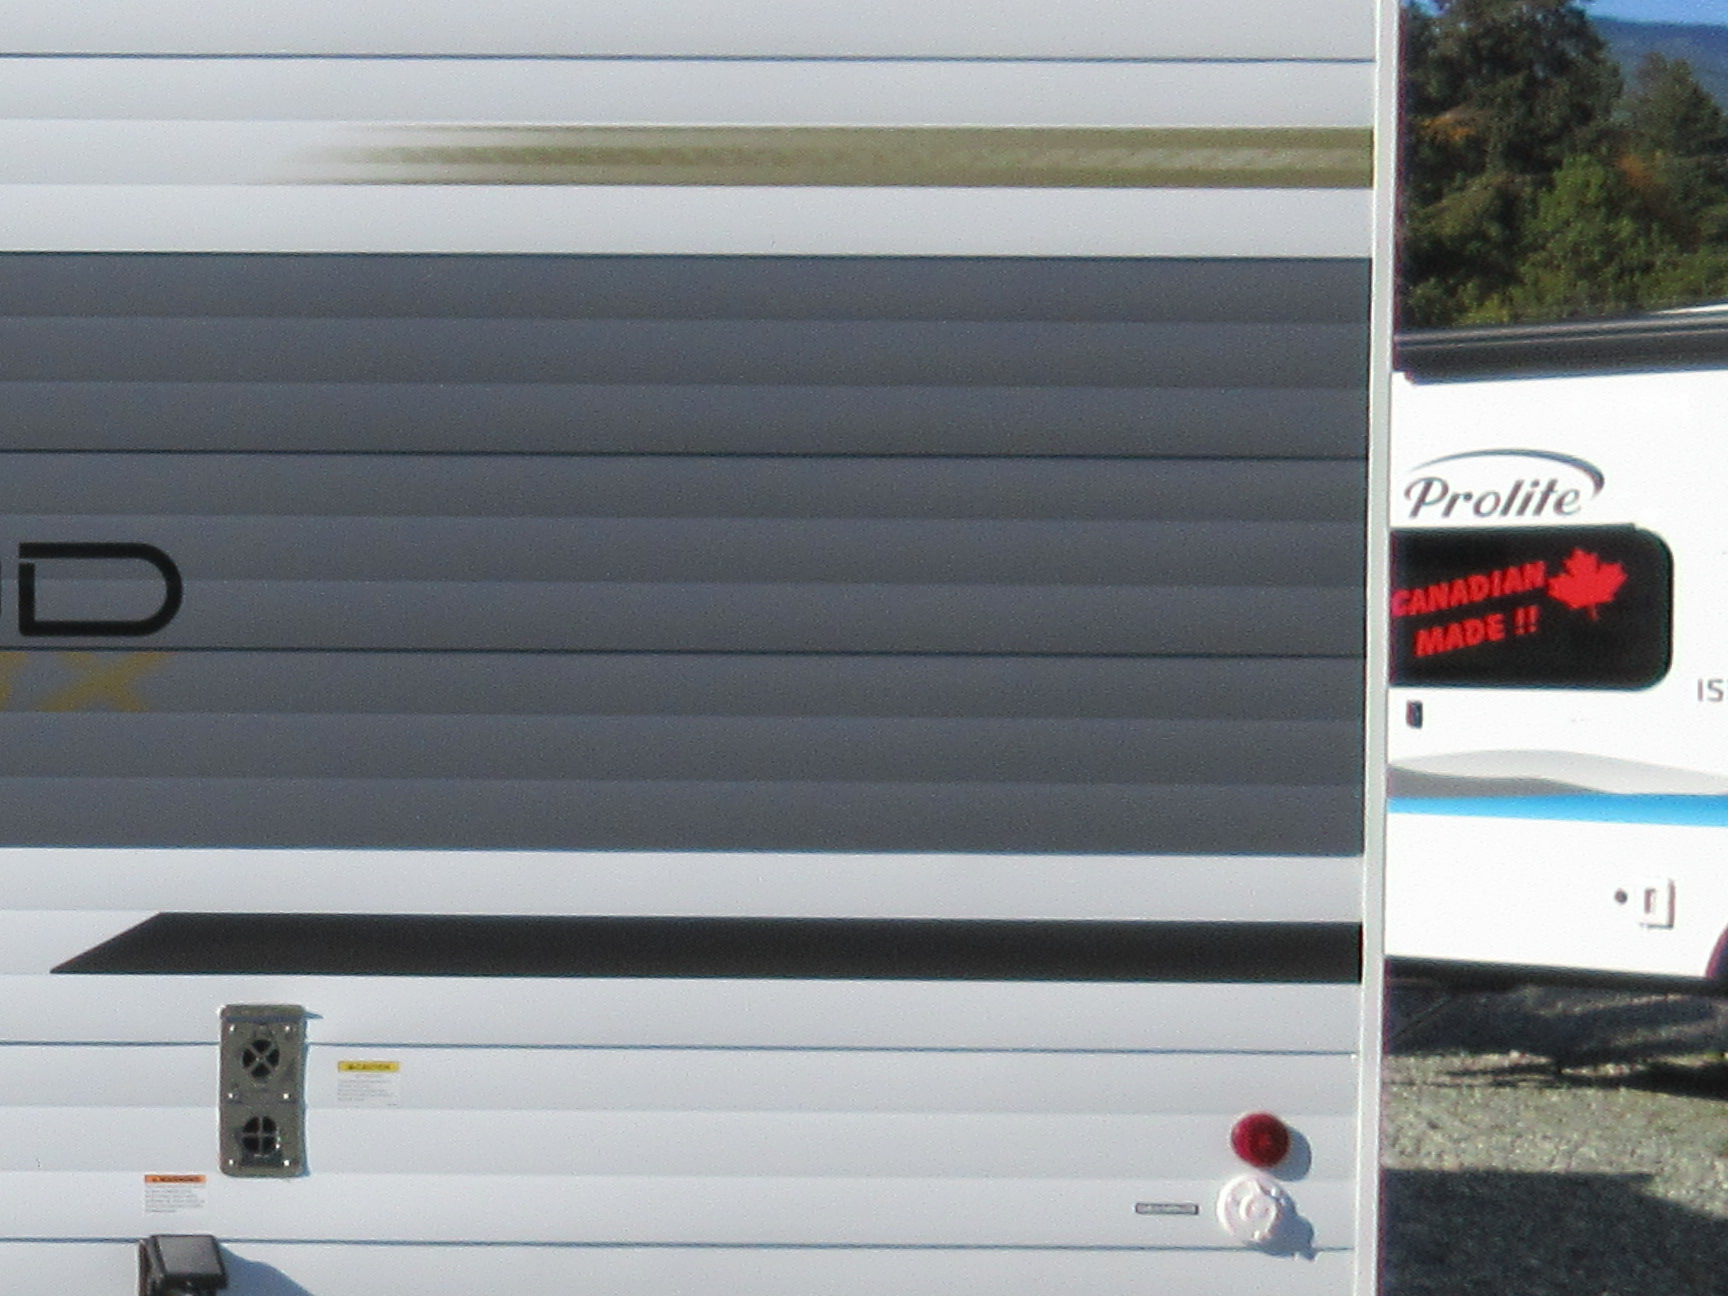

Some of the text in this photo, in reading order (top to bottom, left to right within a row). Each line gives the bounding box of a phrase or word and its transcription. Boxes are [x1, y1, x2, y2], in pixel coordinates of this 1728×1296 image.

[1404, 476, 1582, 518] Prolite
[1391, 560, 1546, 617] CANADIAN
[1413, 612, 1506, 658] MADE
